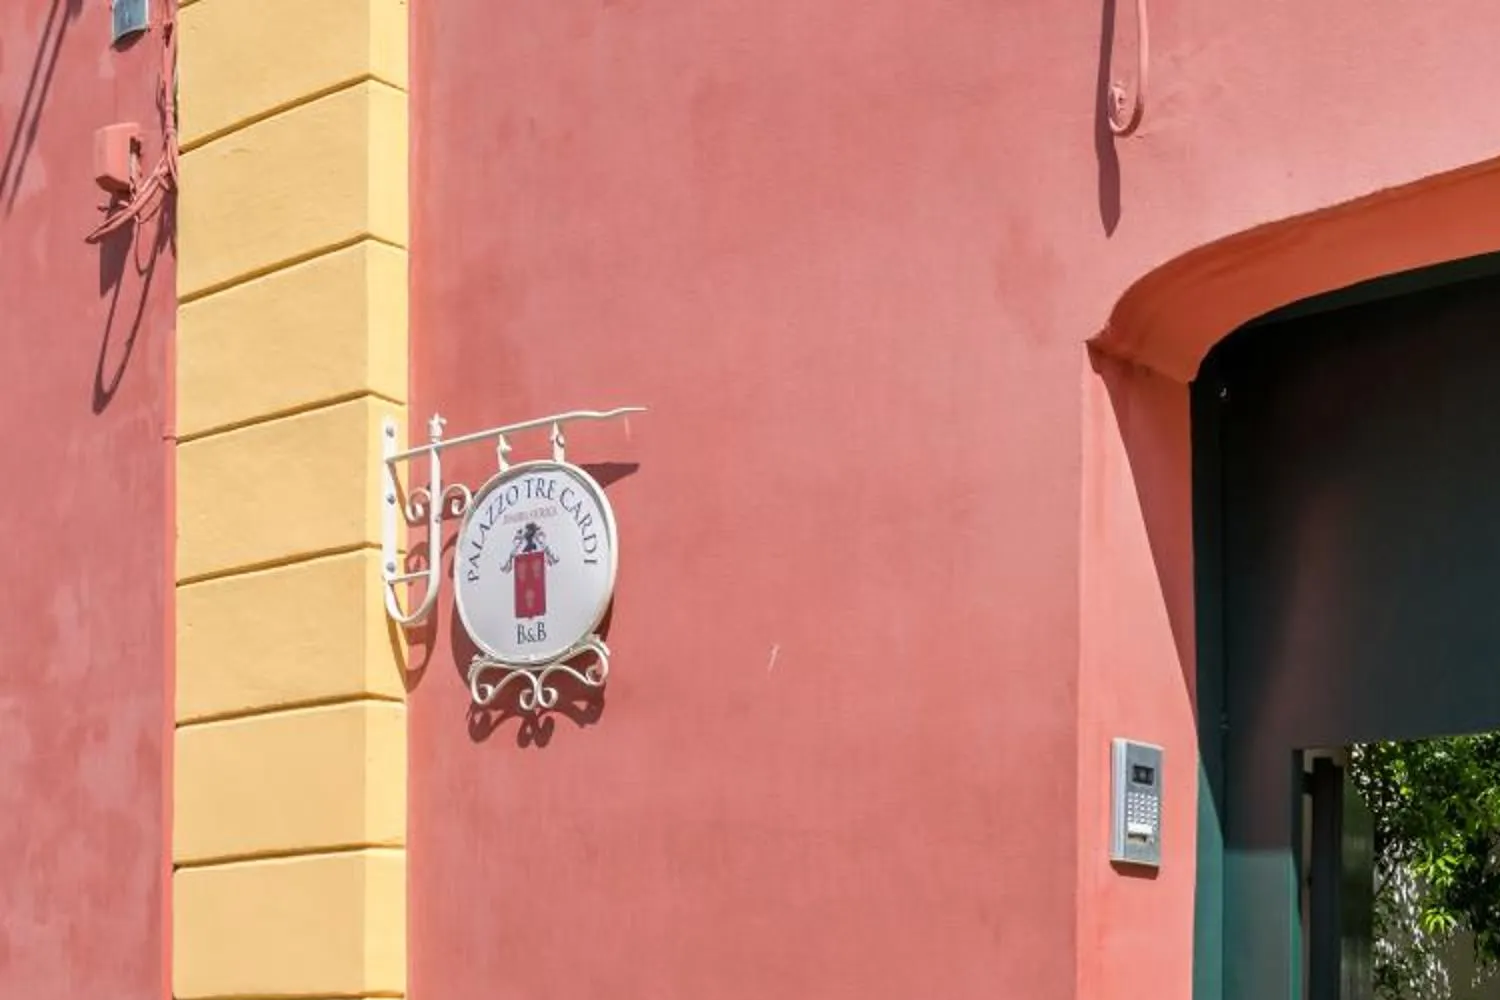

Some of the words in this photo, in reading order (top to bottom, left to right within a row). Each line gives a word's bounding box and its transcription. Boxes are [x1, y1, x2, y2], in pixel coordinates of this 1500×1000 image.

[468, 485, 519, 583] PALAZZO
[524, 478, 556, 500] TRE
[558, 488, 599, 565] CARDI
[517, 622, 547, 644] B&B
